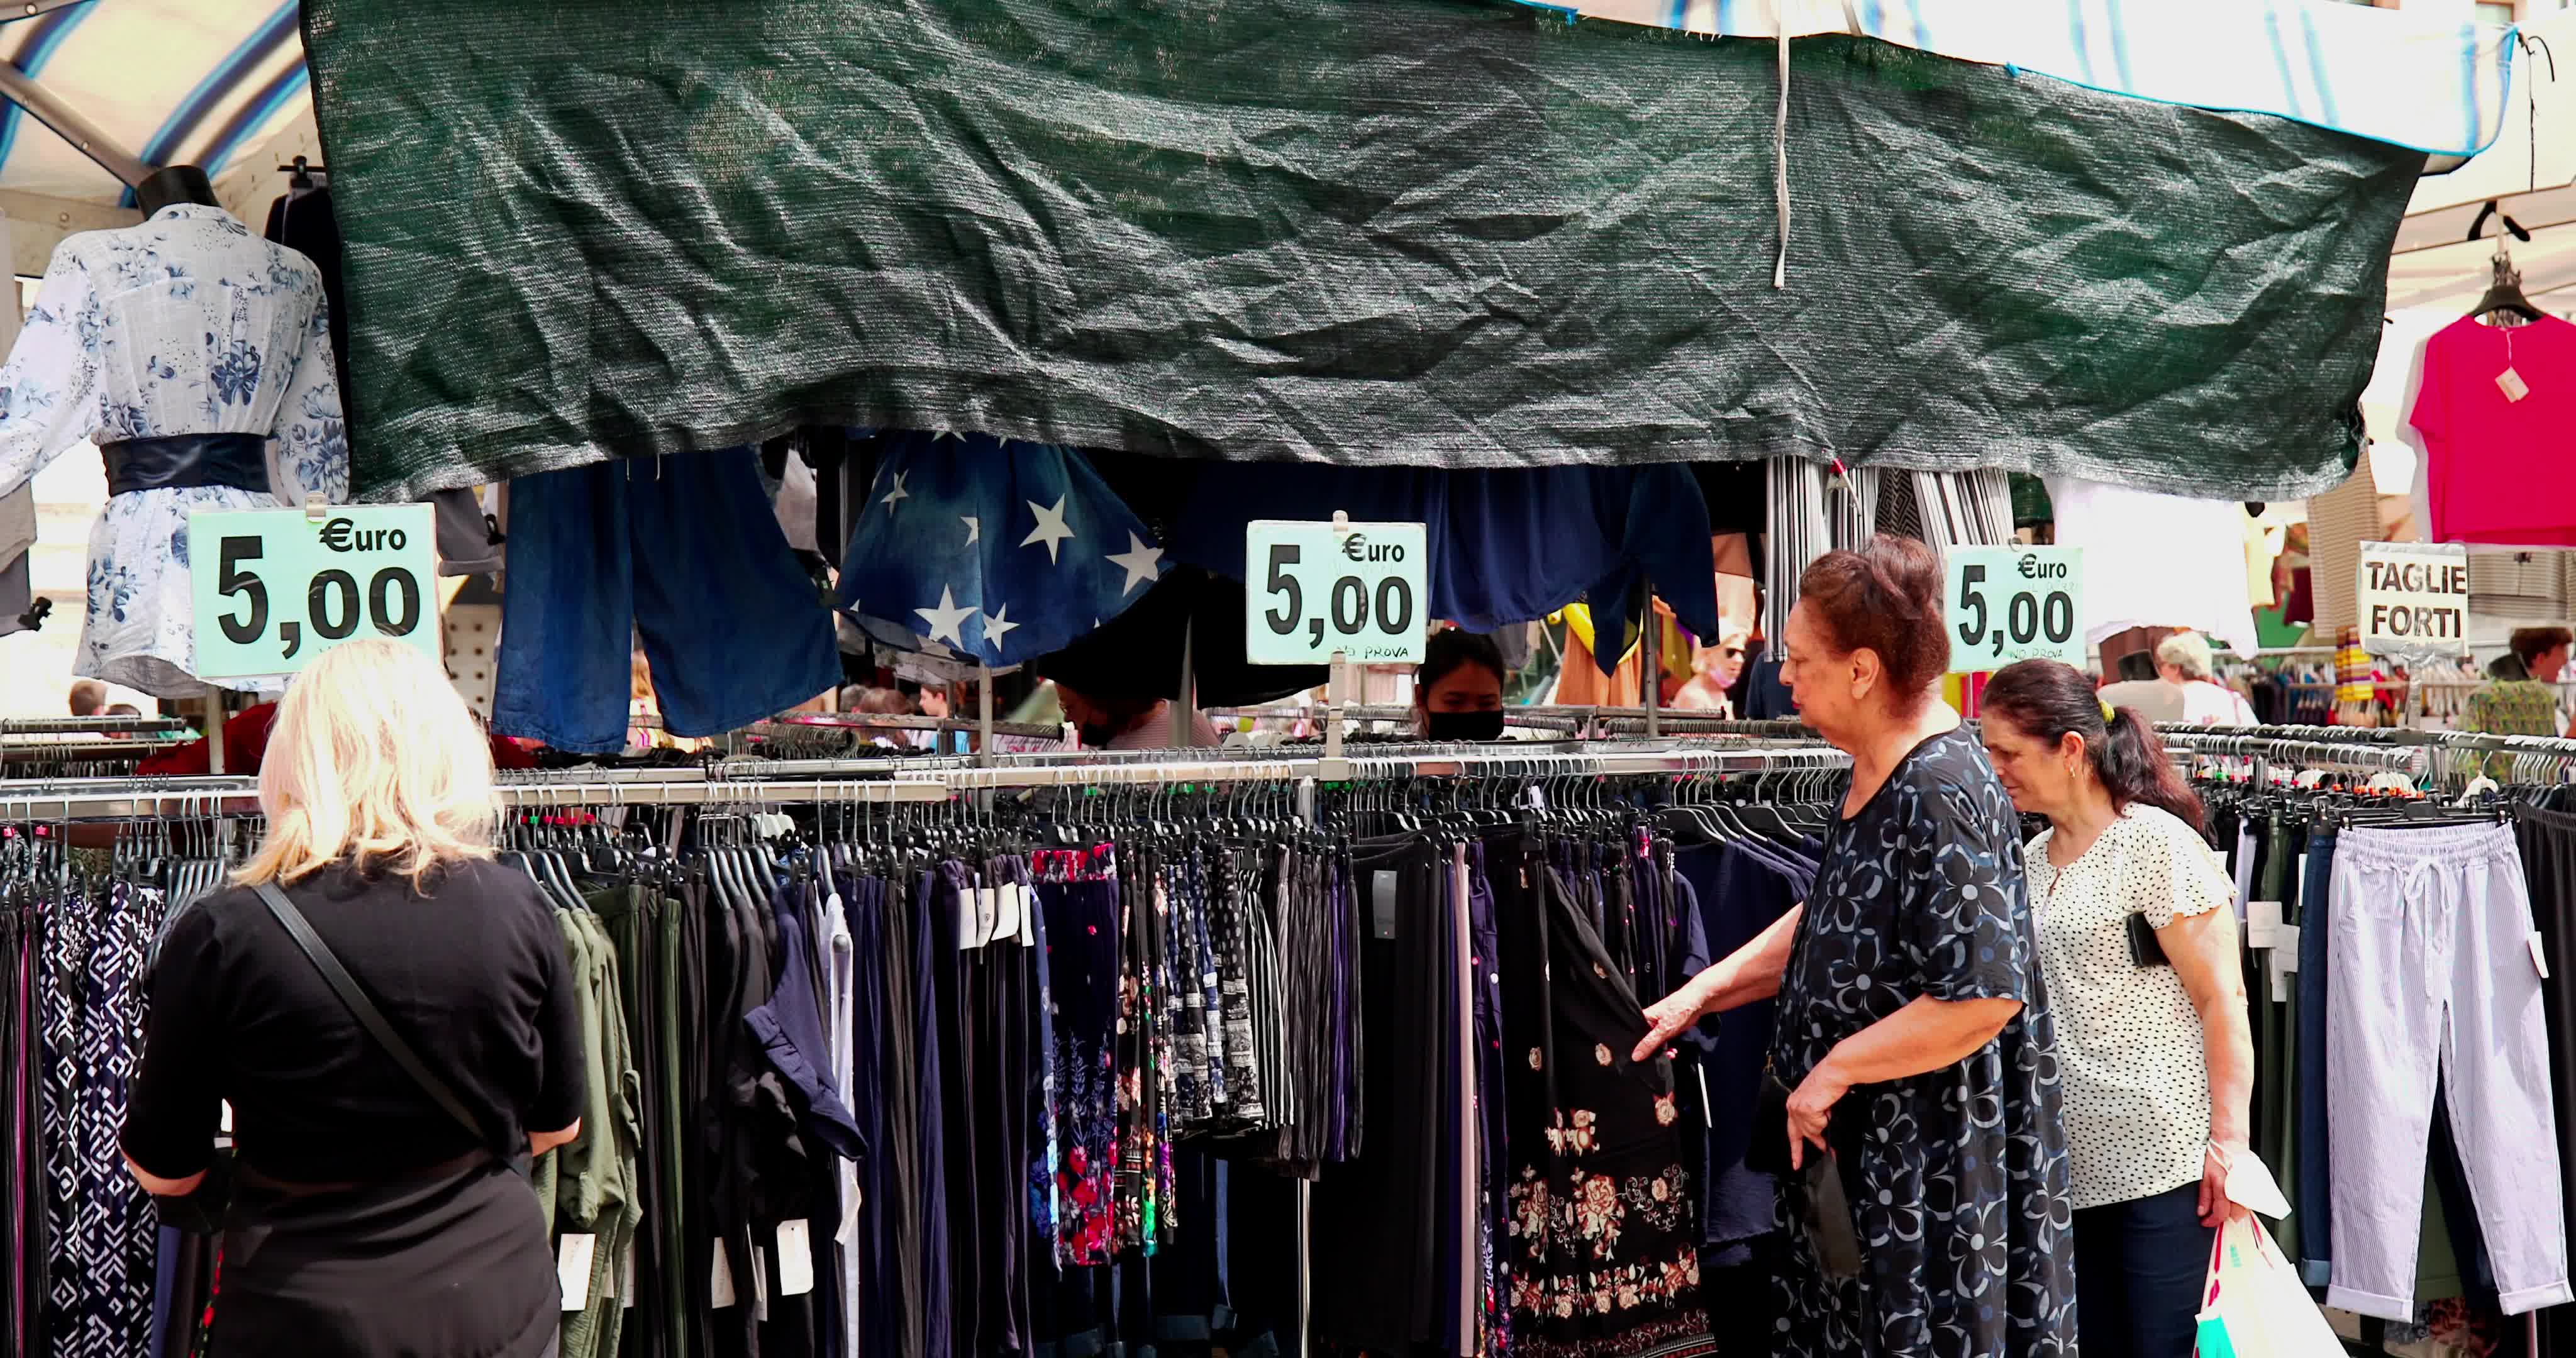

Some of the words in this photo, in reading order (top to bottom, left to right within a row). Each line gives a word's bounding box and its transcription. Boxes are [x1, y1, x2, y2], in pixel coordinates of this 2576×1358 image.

[319, 517, 406, 552] €uro
[1342, 533, 1404, 561] €uro
[2018, 553, 2067, 578] €uro
[2366, 561, 2466, 594] TAGLIE
[218, 536, 420, 660] 5,00
[1265, 544, 1413, 649] 5,00
[1959, 565, 2074, 658] 5,00
[2372, 605, 2461, 638] FORTI
[1365, 646, 1408, 659] PROVA
[2032, 648, 2062, 660] PROVA
